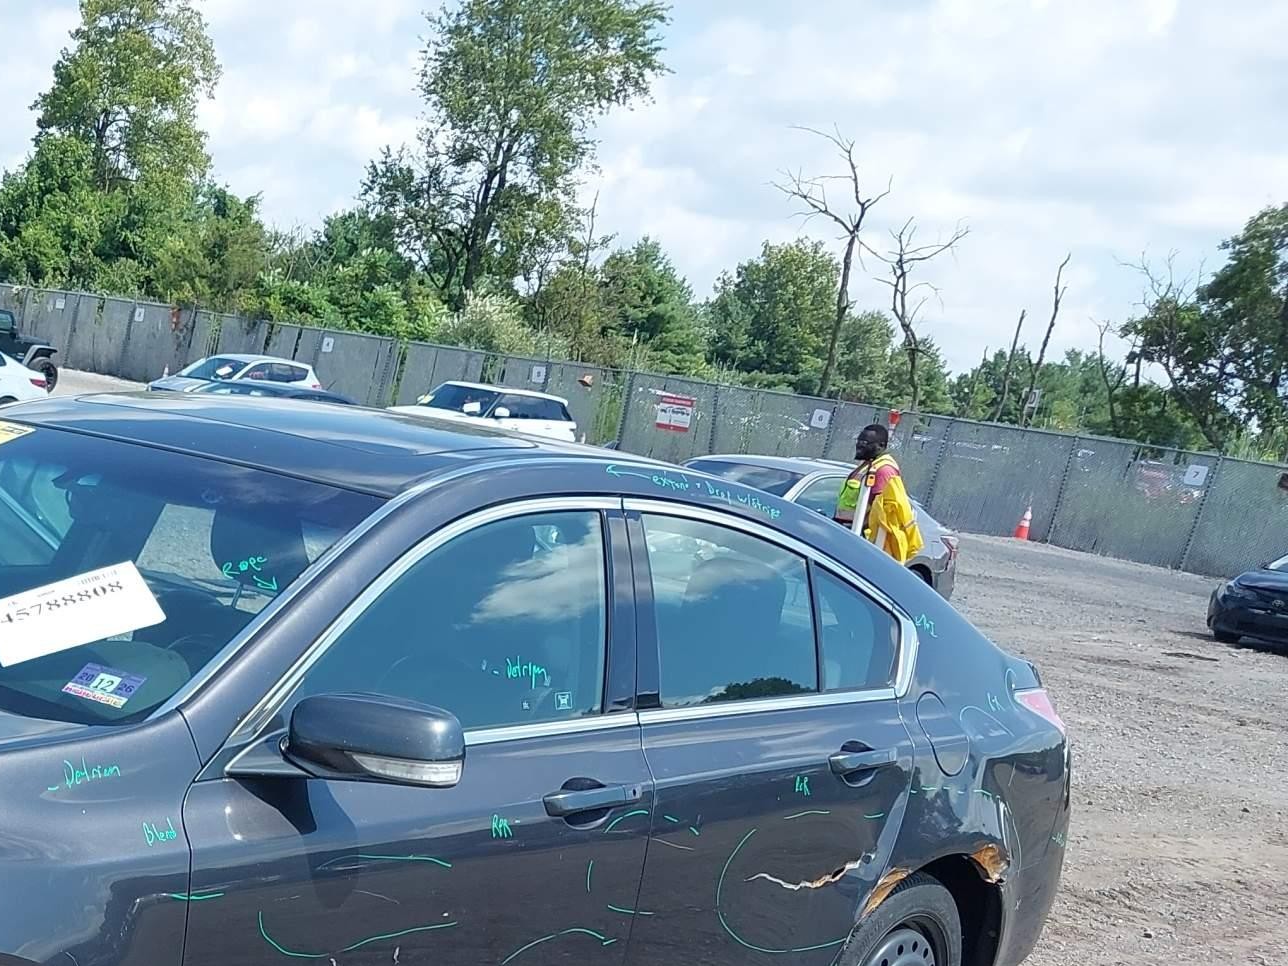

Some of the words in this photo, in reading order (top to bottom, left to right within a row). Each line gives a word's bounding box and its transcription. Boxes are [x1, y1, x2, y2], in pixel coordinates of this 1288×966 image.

[0, 580, 124, 624] 45788808
[78, 672, 94, 682] 20
[93, 678, 115, 692] 12
[119, 683, 136, 693] 26
